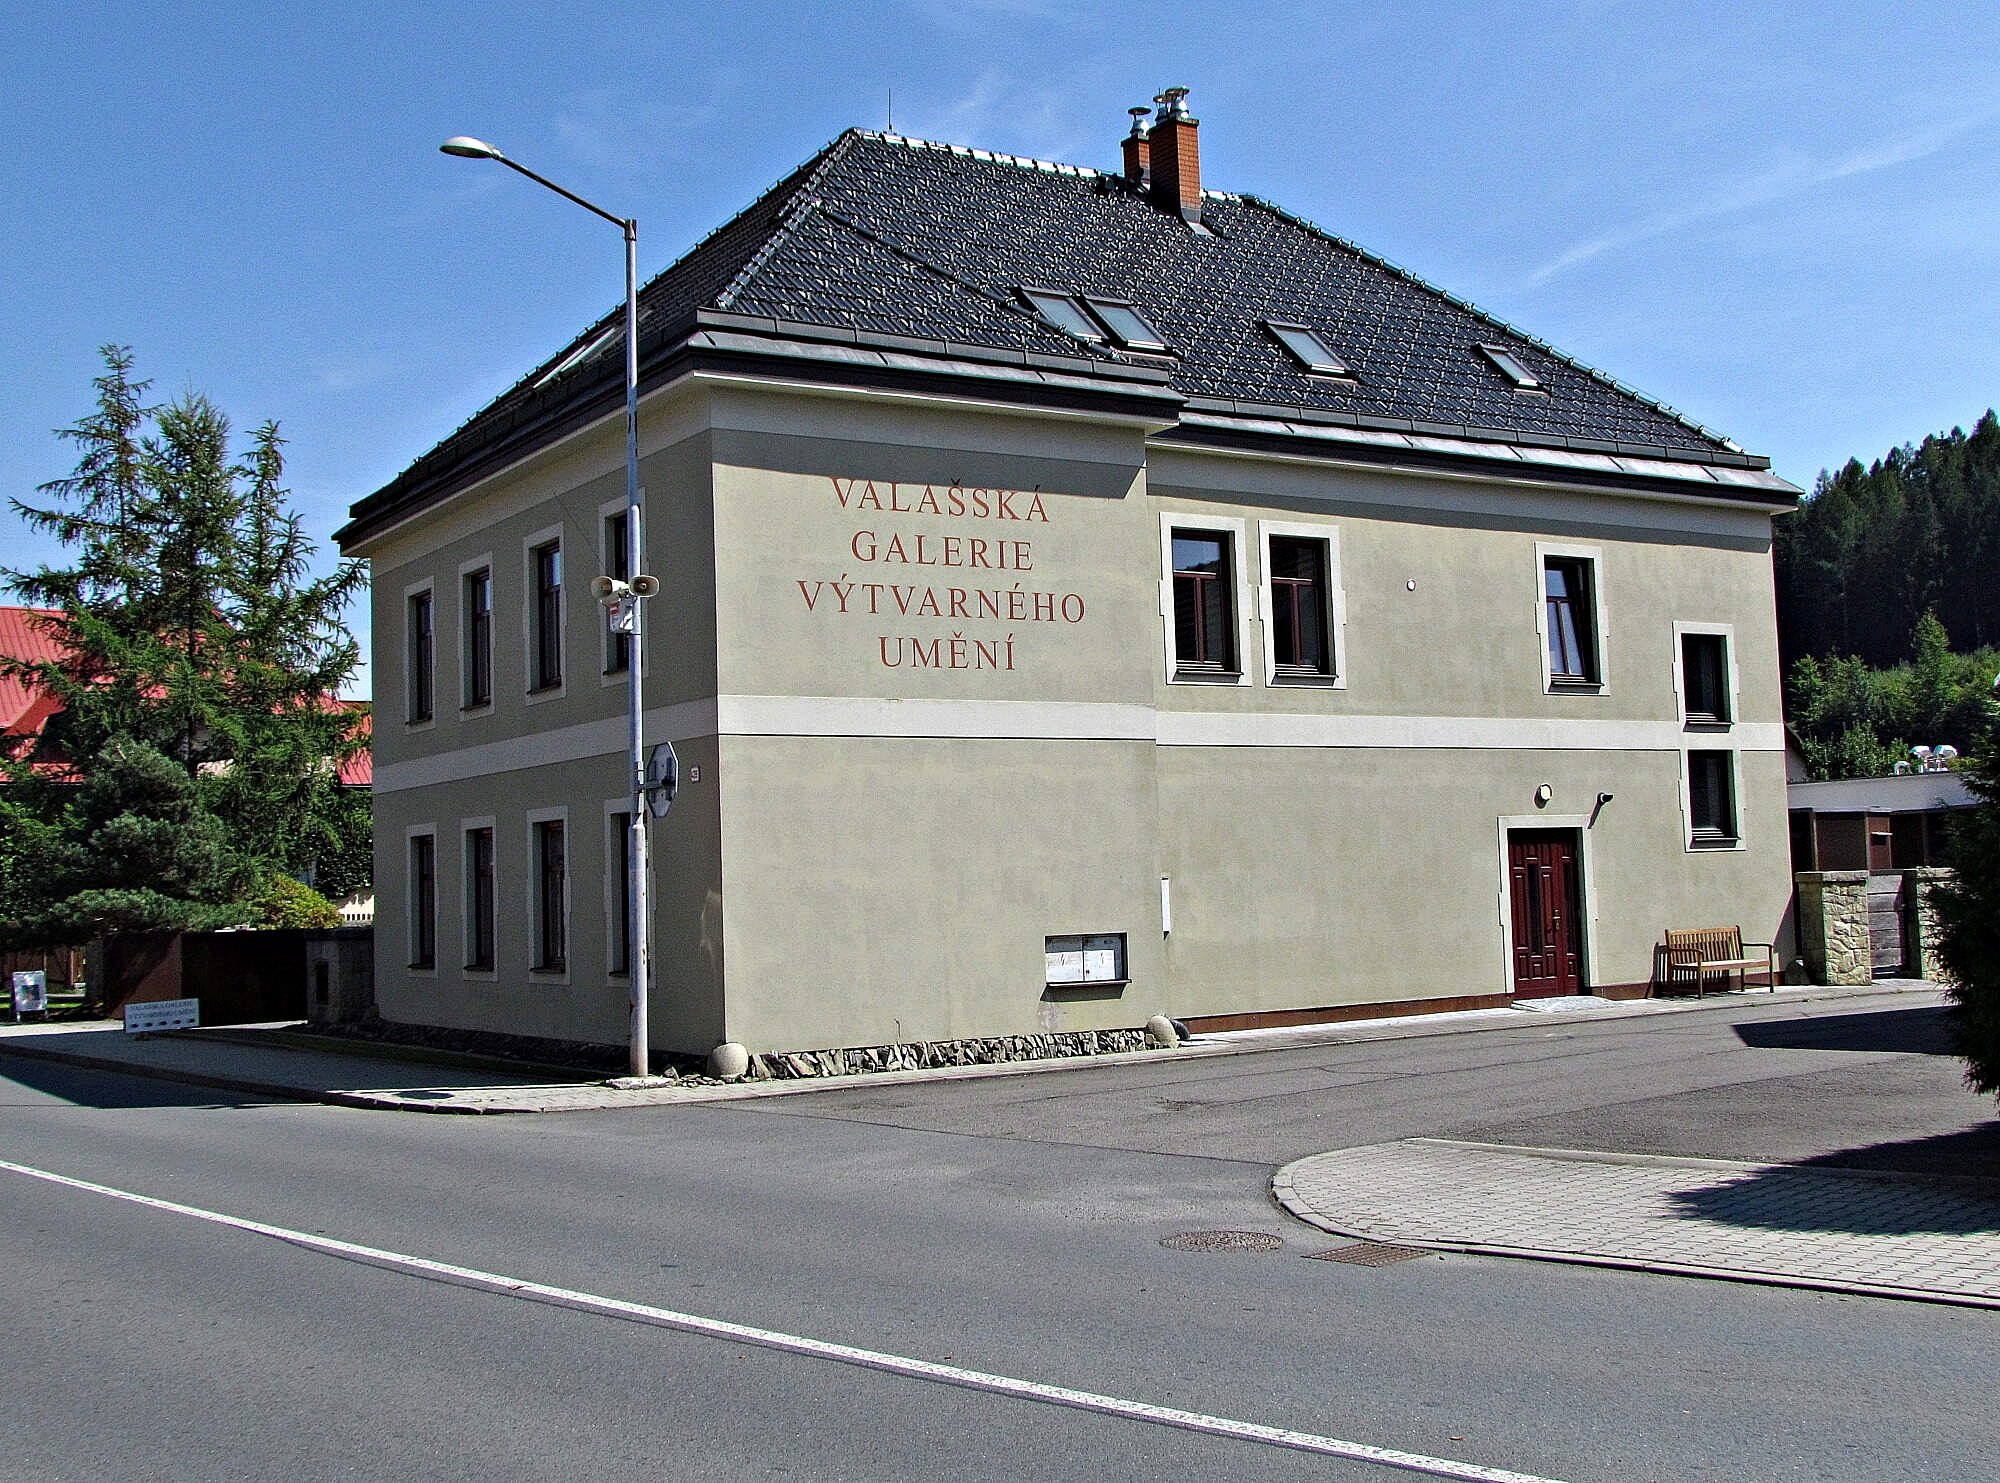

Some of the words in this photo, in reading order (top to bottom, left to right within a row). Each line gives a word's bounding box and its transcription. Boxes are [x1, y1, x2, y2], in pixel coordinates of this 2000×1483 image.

[831, 477, 1049, 522] VALAŠSKÁ
[851, 531, 1034, 571] GALERIE
[796, 574, 1086, 623] VÝTVARNÉHO
[879, 631, 1015, 671] UMĚNÍ
